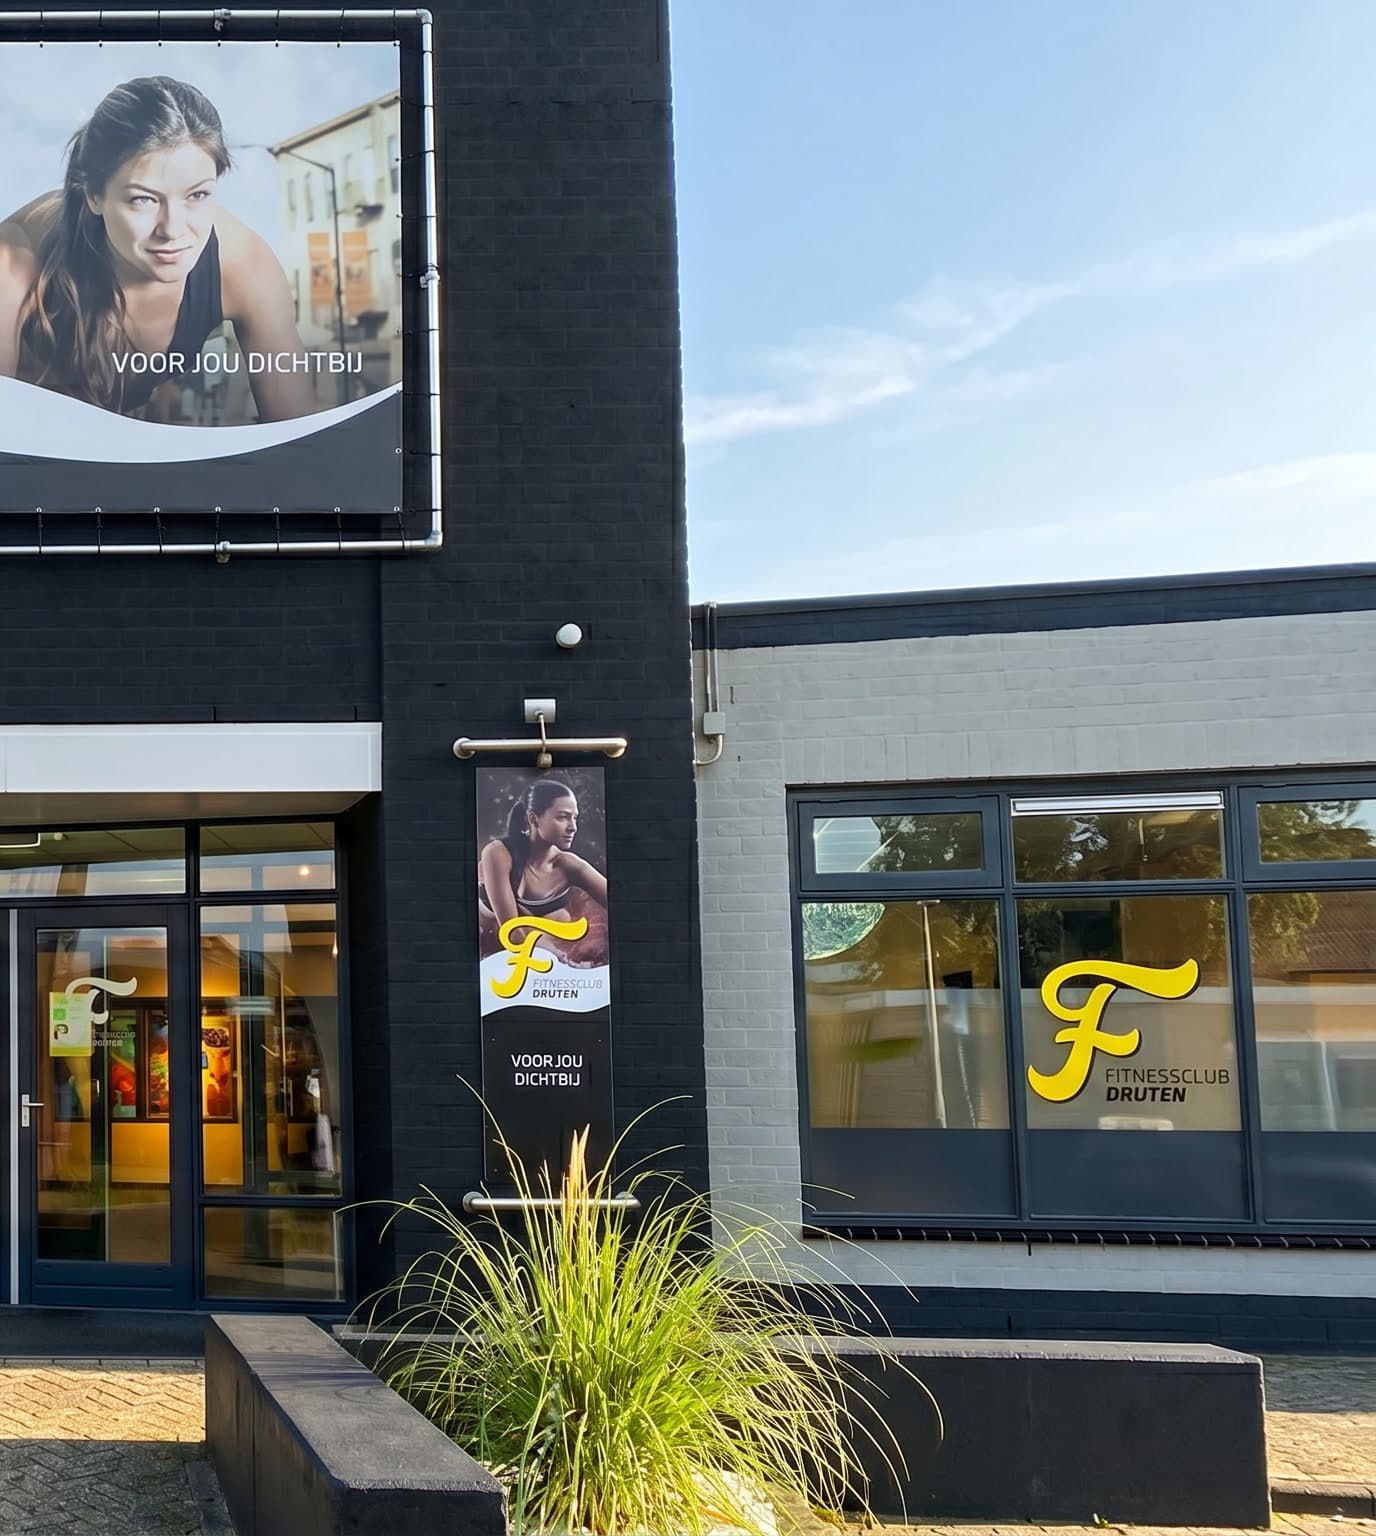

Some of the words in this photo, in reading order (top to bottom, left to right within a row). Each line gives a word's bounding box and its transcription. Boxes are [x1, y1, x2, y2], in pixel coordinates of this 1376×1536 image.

[111, 352, 185, 373] VOOR
[191, 352, 239, 373] JOU
[248, 352, 363, 373] DICHTBIJ
[532, 978, 603, 989] FITNESSCLUB
[532, 989, 579, 999] DRUTEN
[511, 1054, 553, 1068] VOOR
[554, 1054, 583, 1068] JOU
[514, 1072, 581, 1086] DICHTBIJ
[1105, 1068, 1231, 1084] FITNESSCLUB
[1106, 1086, 1187, 1103] DRUTEN
